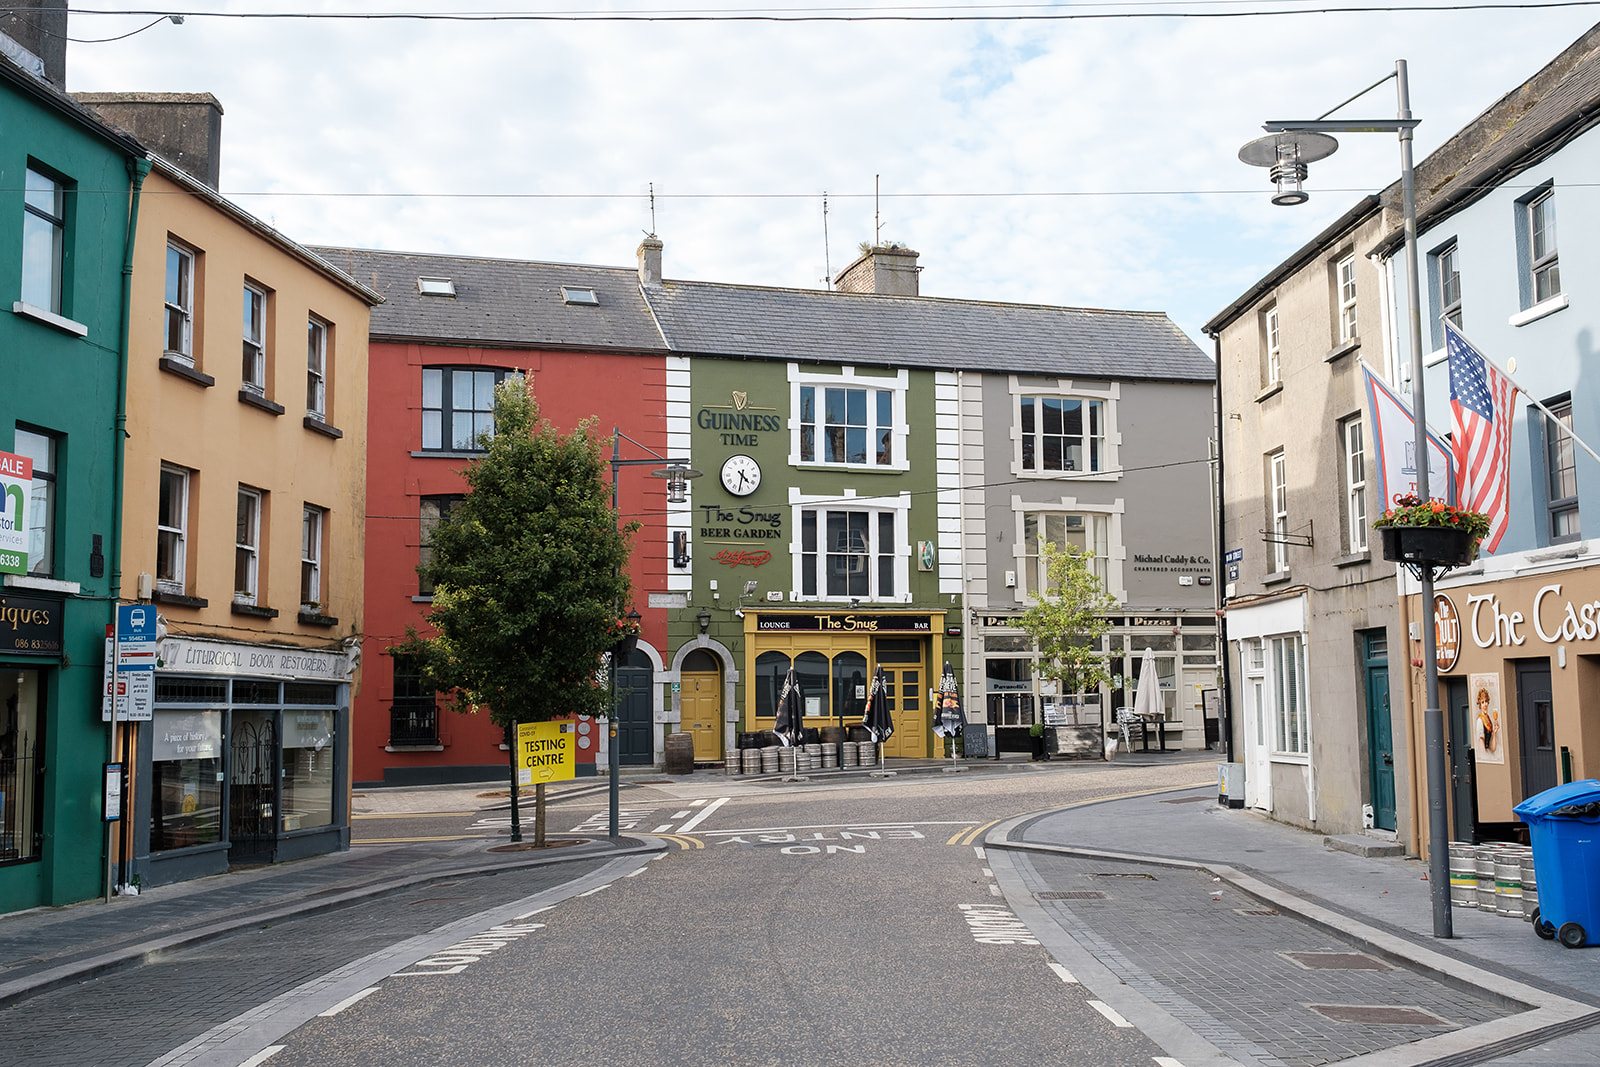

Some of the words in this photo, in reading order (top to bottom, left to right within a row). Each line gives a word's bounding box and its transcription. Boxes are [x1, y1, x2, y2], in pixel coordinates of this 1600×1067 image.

[697, 409, 780, 432] GUINNESS
[720, 434, 758, 447] TIME
[0, 457, 23, 475] ALE
[0, 517, 14, 530] tor
[700, 505, 734, 524] The
[737, 505, 781, 527] Snug
[700, 528, 731, 538] BEER
[733, 529, 781, 539] GARDEN
[1134, 555, 1163, 563] Michael
[1164, 555, 1188, 565] Cuddy
[1190, 556, 1196, 564] &
[1198, 556, 1210, 564] Co.
[814, 615, 841, 631] The
[843, 615, 878, 631] Snug
[1134, 617, 1171, 626] Pizzas
[1467, 593, 1526, 648] The
[249, 653, 276, 669] BOOK
[525, 738, 566, 753] TESTING
[526, 753, 564, 768] CENTRE
[715, 830, 926, 845] ENTRY
[780, 844, 866, 855] NO
